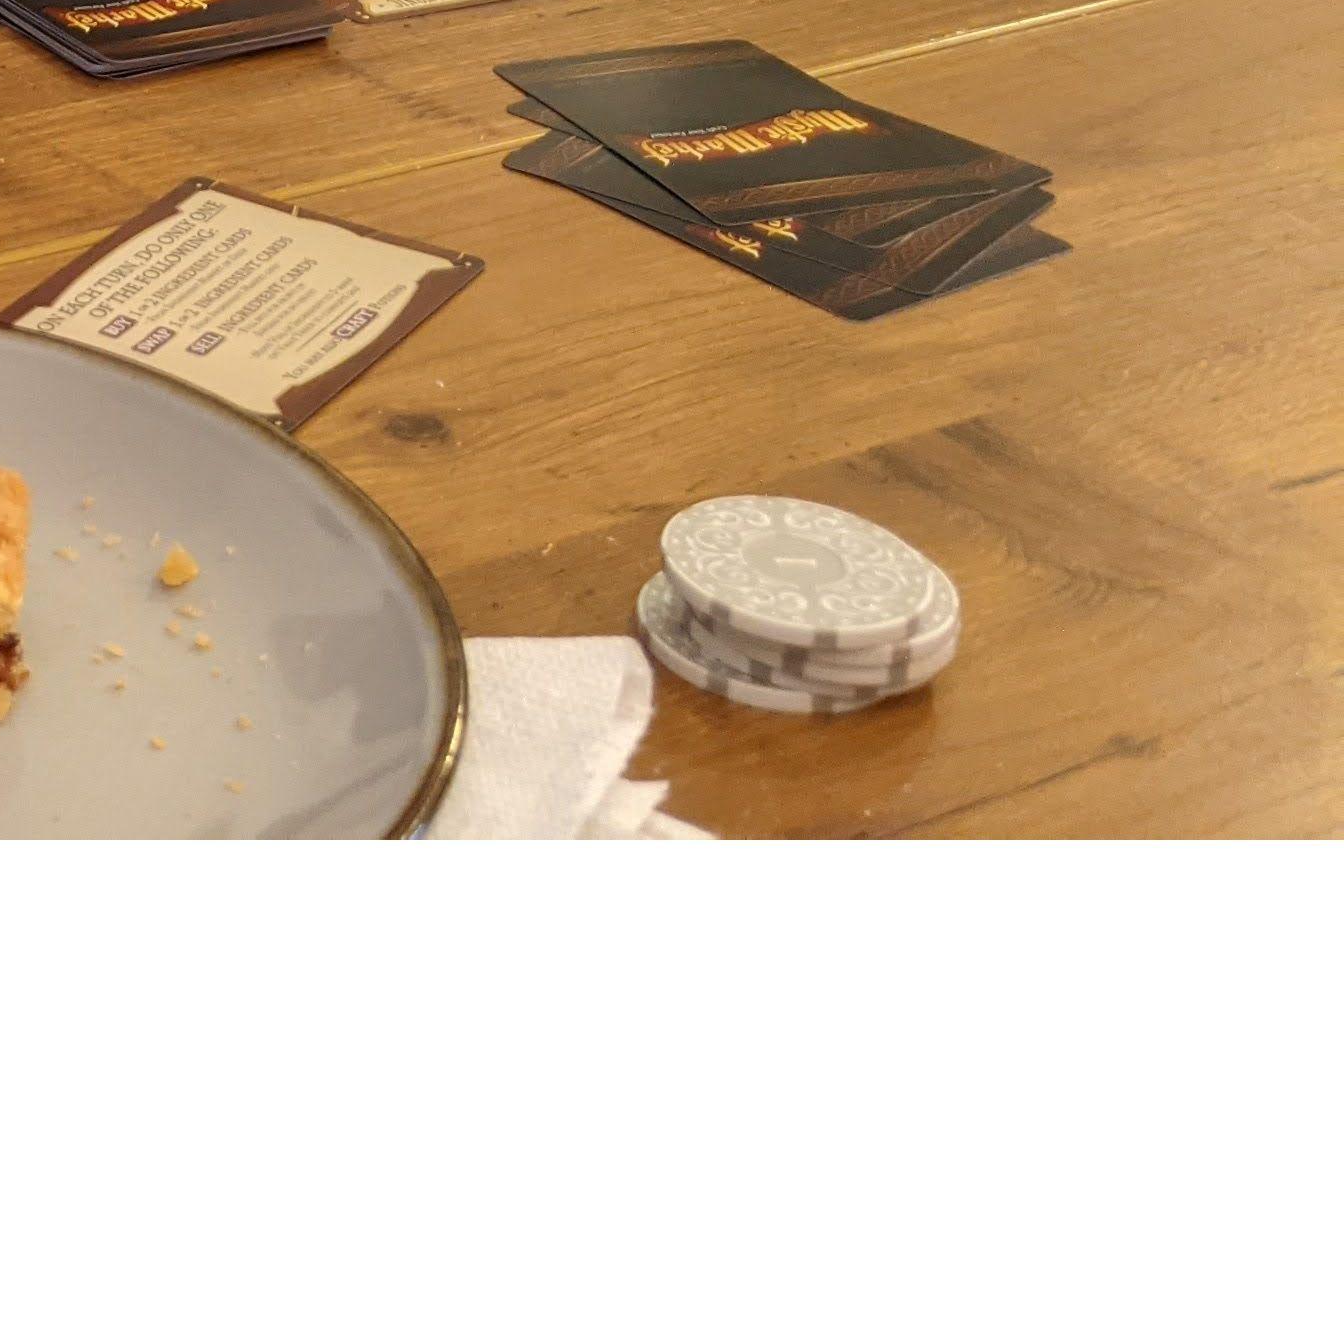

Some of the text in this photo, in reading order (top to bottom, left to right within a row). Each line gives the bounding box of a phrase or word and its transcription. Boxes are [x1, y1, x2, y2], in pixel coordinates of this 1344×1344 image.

[66, 0, 178, 33] Market
[641, 109, 870, 167] Mystic Market
[37, 314, 67, 332] ON
[57, 287, 105, 316] EACH
[132, 243, 165, 261] DO
[153, 219, 198, 245] ONLY
[186, 199, 224, 220] ONE
[86, 300, 118, 319] OF
[104, 281, 144, 304] THE
[102, 317, 133, 335] BUY
[148, 252, 221, 300] INGREDIENT
[210, 227, 255, 254] CARDS
[136, 328, 174, 352] SWAP
[192, 261, 263, 308] INGREDIENT
[252, 235, 296, 262] CARDS
[189, 332, 222, 353] SELL
[216, 282, 288, 332] INGREDIENT
[276, 257, 320, 284] CARDS
